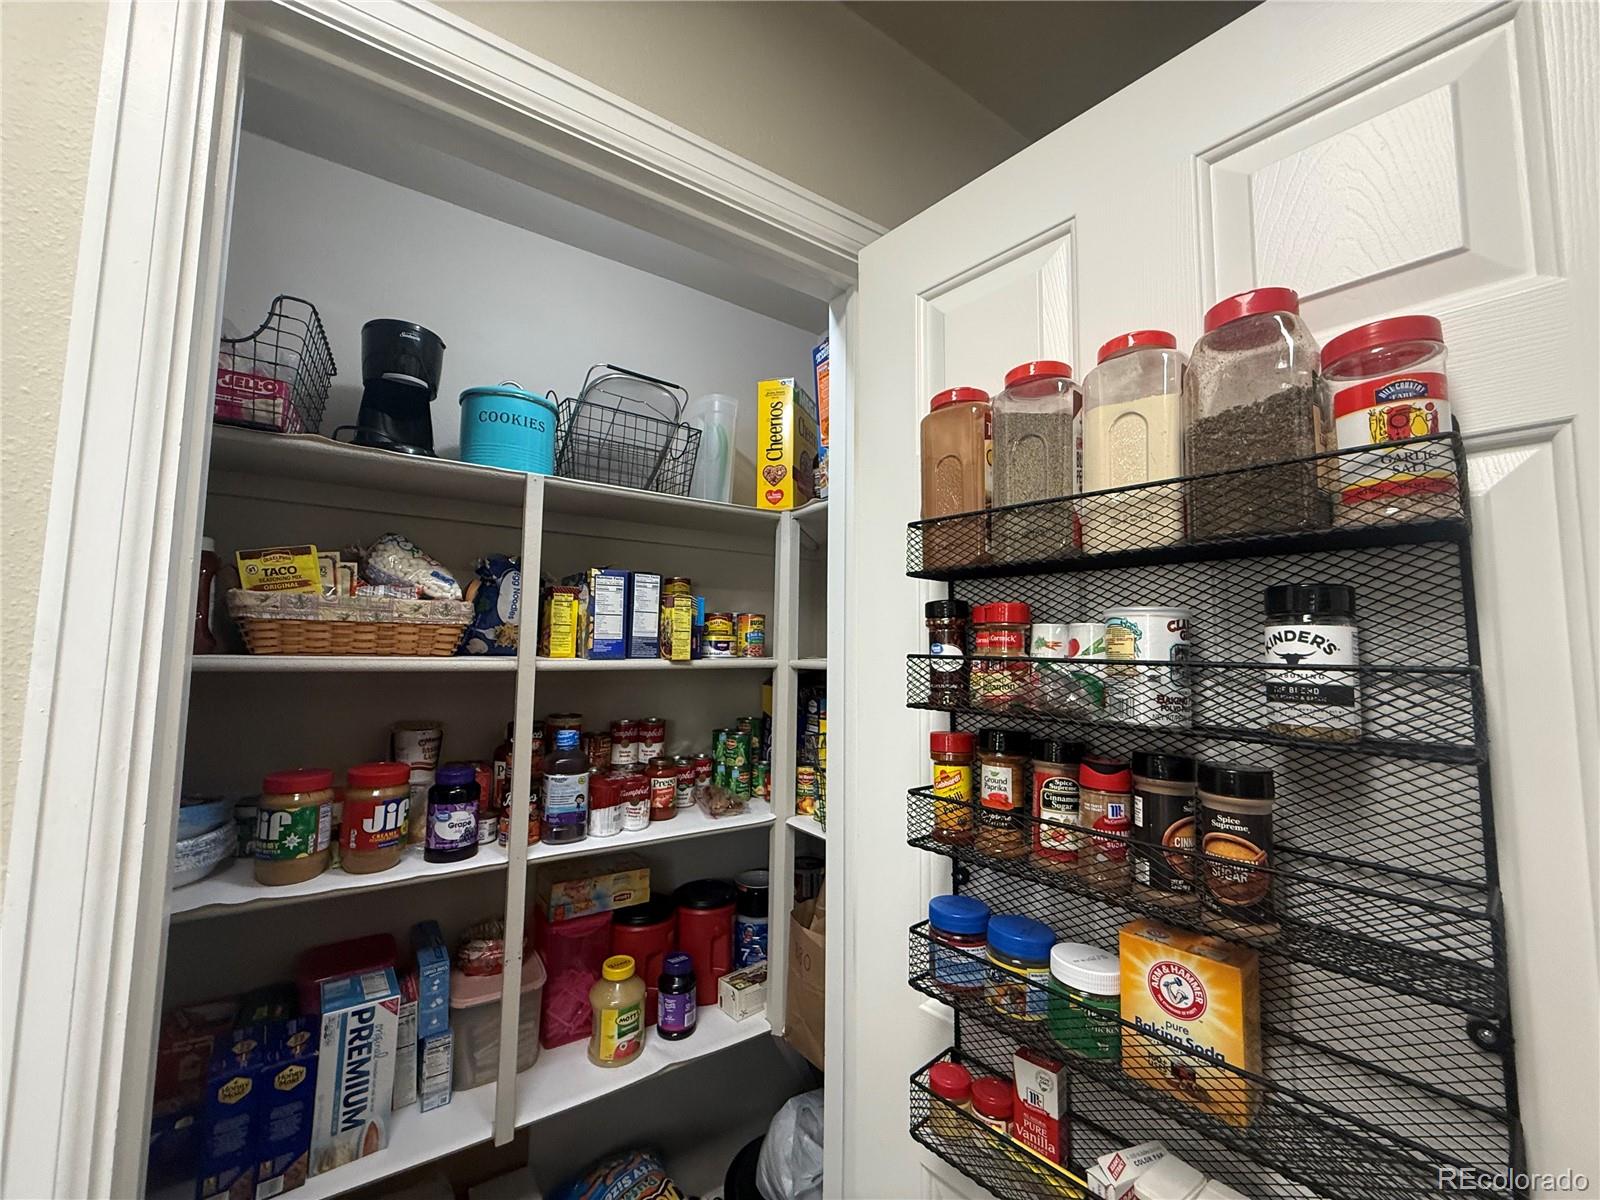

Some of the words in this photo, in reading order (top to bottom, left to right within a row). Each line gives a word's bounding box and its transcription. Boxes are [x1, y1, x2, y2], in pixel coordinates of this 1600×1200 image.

[1378, 386, 1395, 398] HILL
[1395, 381, 1427, 394] COUNTRY
[478, 411, 546, 433] COOKIES
[765, 401, 784, 462] Cheerios
[1381, 449, 1438, 465] GARLIC
[1392, 461, 1430, 474] SALT
[262, 566, 297, 577] TACO
[263, 582, 299, 591] ORIGINAL
[508, 588, 521, 620] Noodles
[1265, 630, 1338, 656] KINDER'S
[984, 775, 1008, 785] Ground
[984, 782, 1008, 792] Paprika
[1049, 782, 1077, 791] Supreme
[1054, 779, 1073, 787] Spice
[1052, 800, 1073, 812] Sugar
[363, 799, 409, 833] Jif
[1217, 814, 1240, 825] Spice
[448, 820, 471, 830] Grape
[1211, 819, 1249, 832] Supreme
[1151, 968, 1164, 989] ARM
[1161, 965, 1170, 974] &
[1170, 964, 1204, 1005] HAMMER
[1165, 1021, 1189, 1036] pure
[1135, 1016, 1183, 1045] Baking
[1186, 1037, 1226, 1064] Soda
[341, 1005, 376, 1133] PREMIUM
[1024, 1119, 1047, 1137] PURE
[1016, 1123, 1056, 1154] Vanilla
